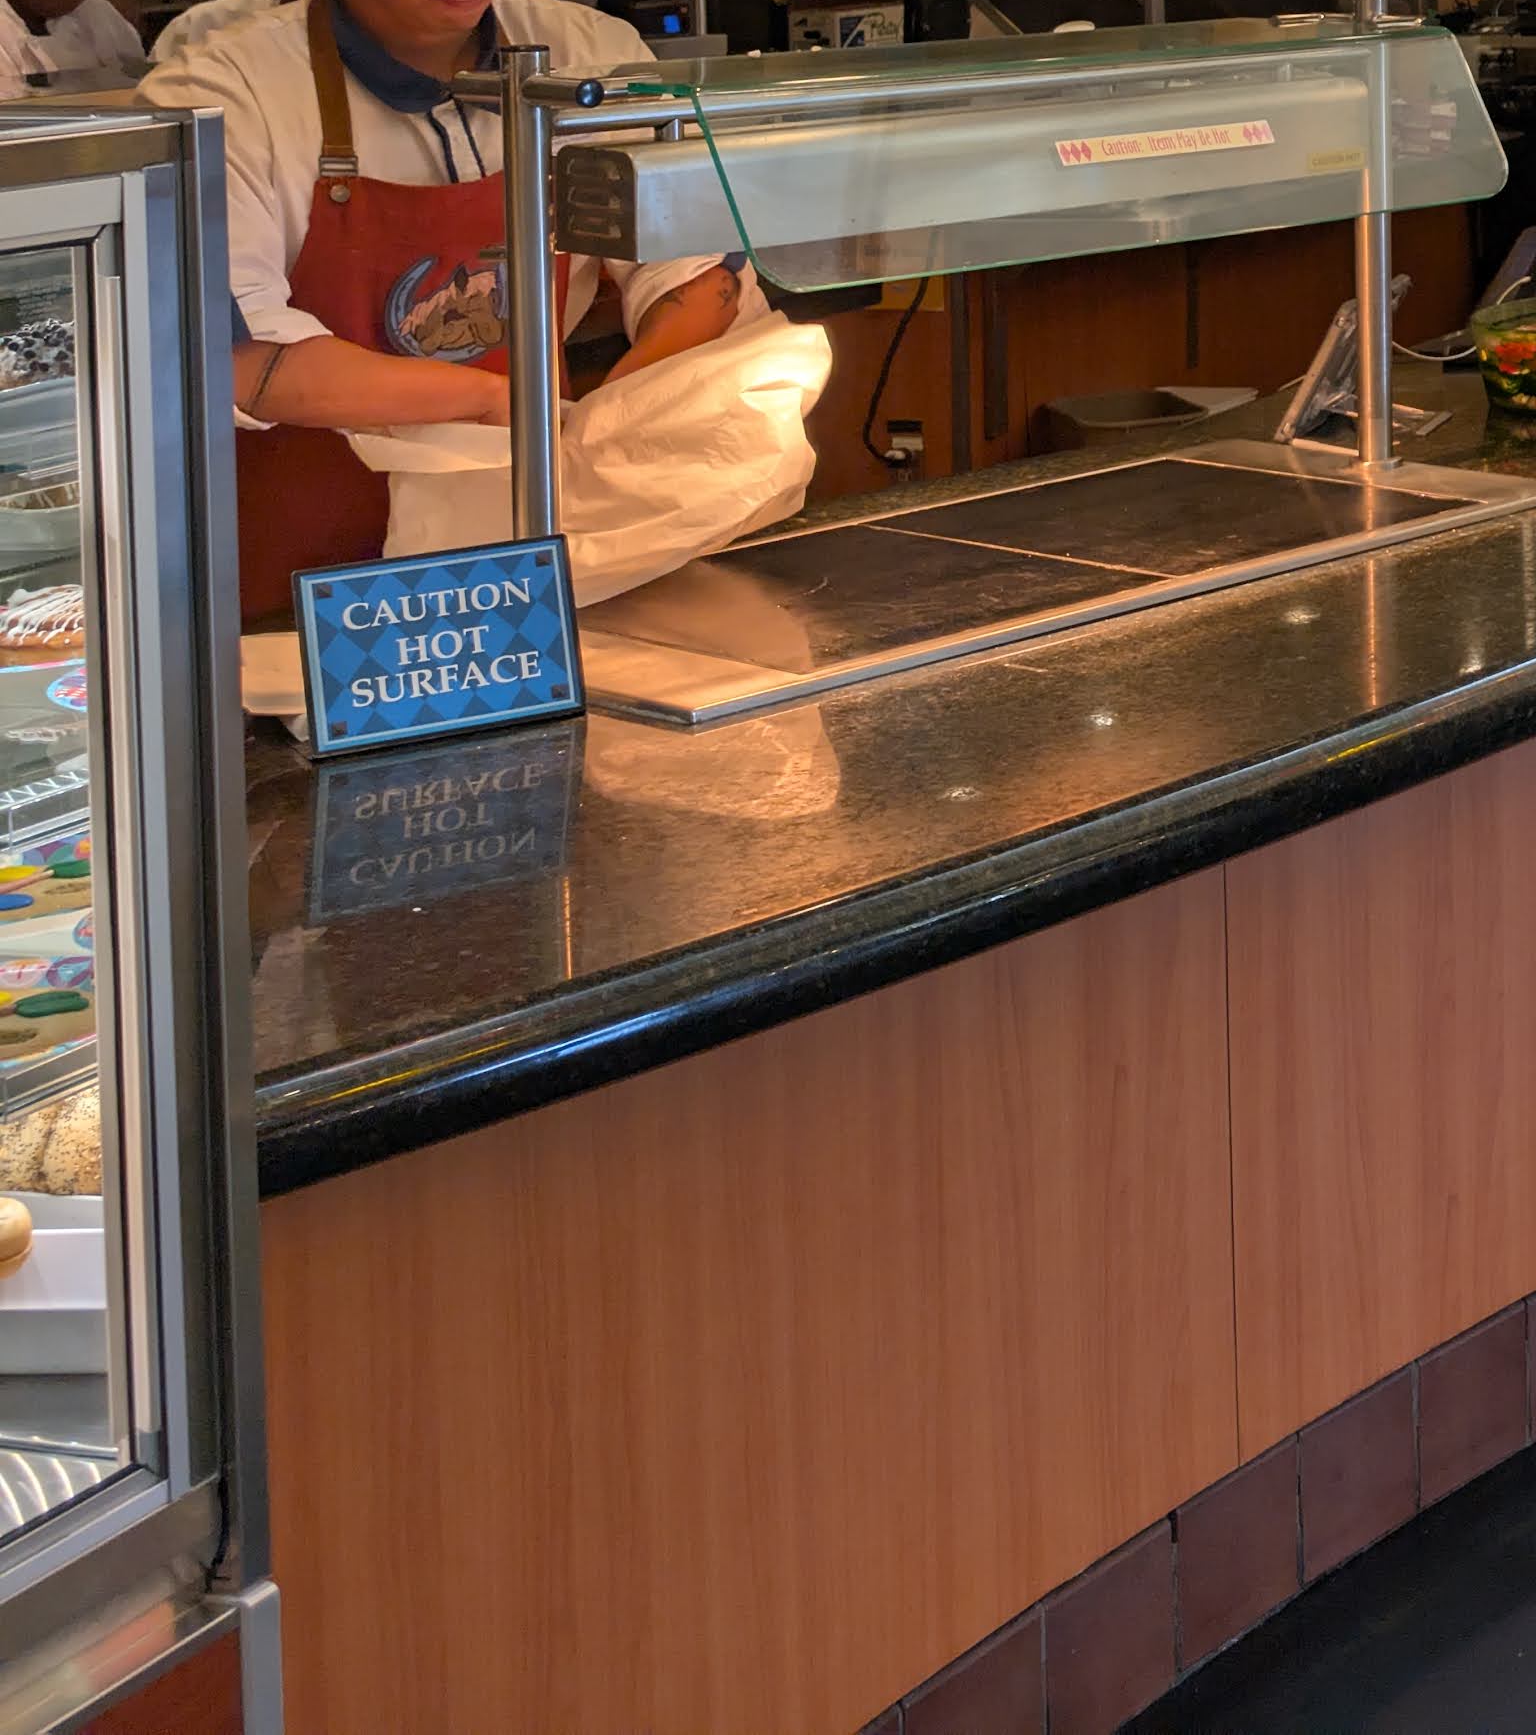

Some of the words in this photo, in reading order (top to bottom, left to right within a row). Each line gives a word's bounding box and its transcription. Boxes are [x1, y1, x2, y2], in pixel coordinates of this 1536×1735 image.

[1101, 138, 1143, 157] Caution:
[1176, 131, 1198, 152] May
[1200, 129, 1213, 146] Be
[1213, 128, 1232, 144] Hot
[342, 577, 531, 631] CAUTION
[395, 625, 490, 666] HOT
[351, 650, 542, 708] SURFACE
